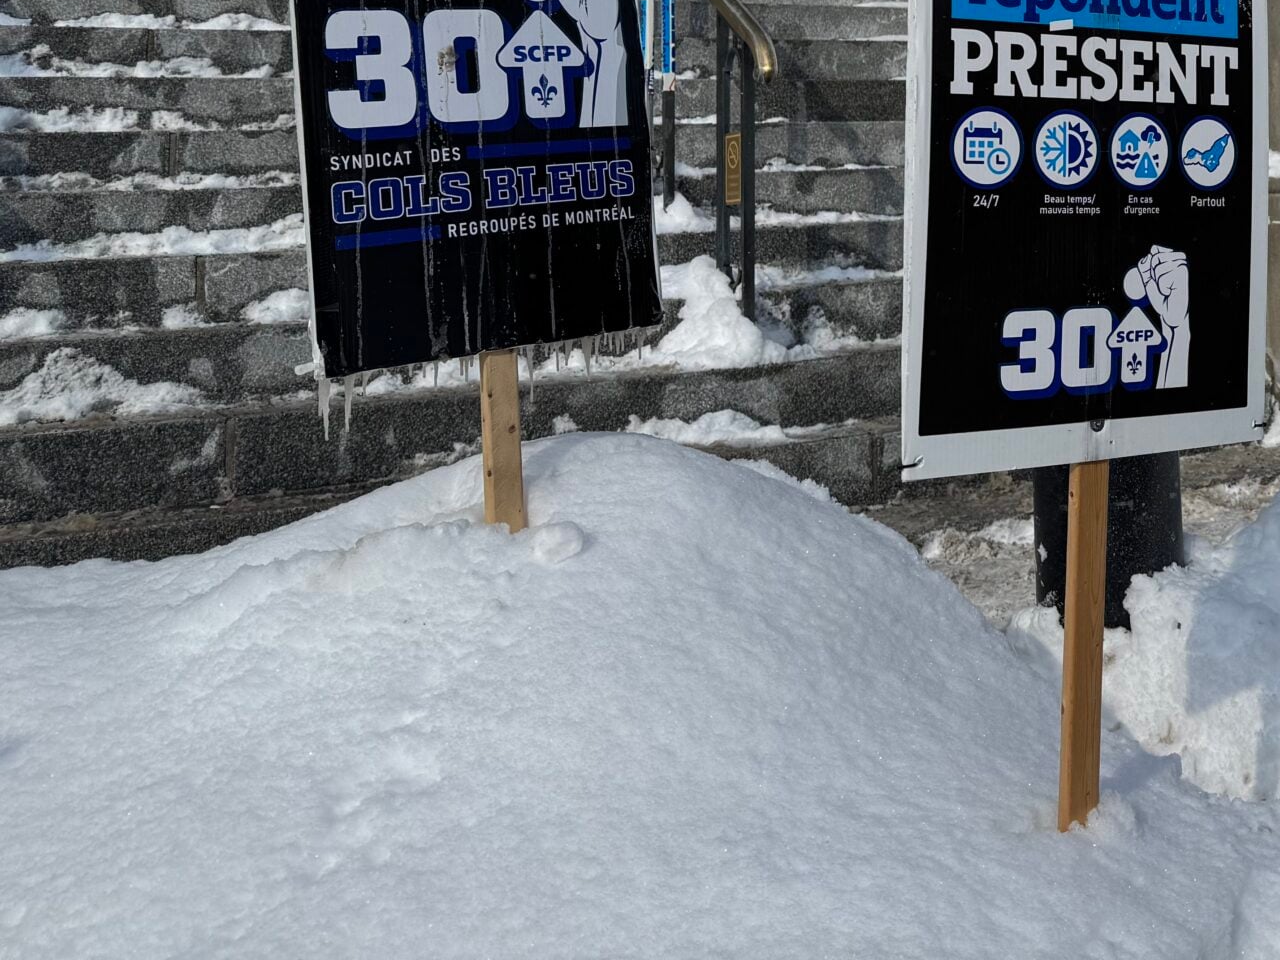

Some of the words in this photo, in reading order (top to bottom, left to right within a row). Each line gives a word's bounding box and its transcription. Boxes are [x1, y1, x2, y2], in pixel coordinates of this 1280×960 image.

[514, 45, 572, 63] SCFP
[950, 18, 1239, 106] PRÉSENT
[325, 8, 510, 130] 30
[330, 150, 413, 172] SYNDICAT
[430, 147, 461, 164] DES
[331, 171, 473, 225] COLS
[483, 159, 636, 209] BLEUS
[1044, 194, 1066, 204] Beau
[1067, 194, 1096, 206] temps/
[1128, 195, 1139, 204] En
[1140, 196, 1153, 204] cas
[973, 194, 1000, 208] 24/7
[1190, 195, 1226, 207] Partout
[1040, 205, 1074, 214] mauvais
[1075, 205, 1101, 216] temps
[1124, 205, 1160, 216] d'urgence
[448, 213, 537, 238] REGROUPÉS
[542, 213, 560, 228] DE
[565, 204, 636, 226] MONTRÉAL
[1116, 330, 1154, 344] SCFP
[1000, 307, 1112, 392] 30
